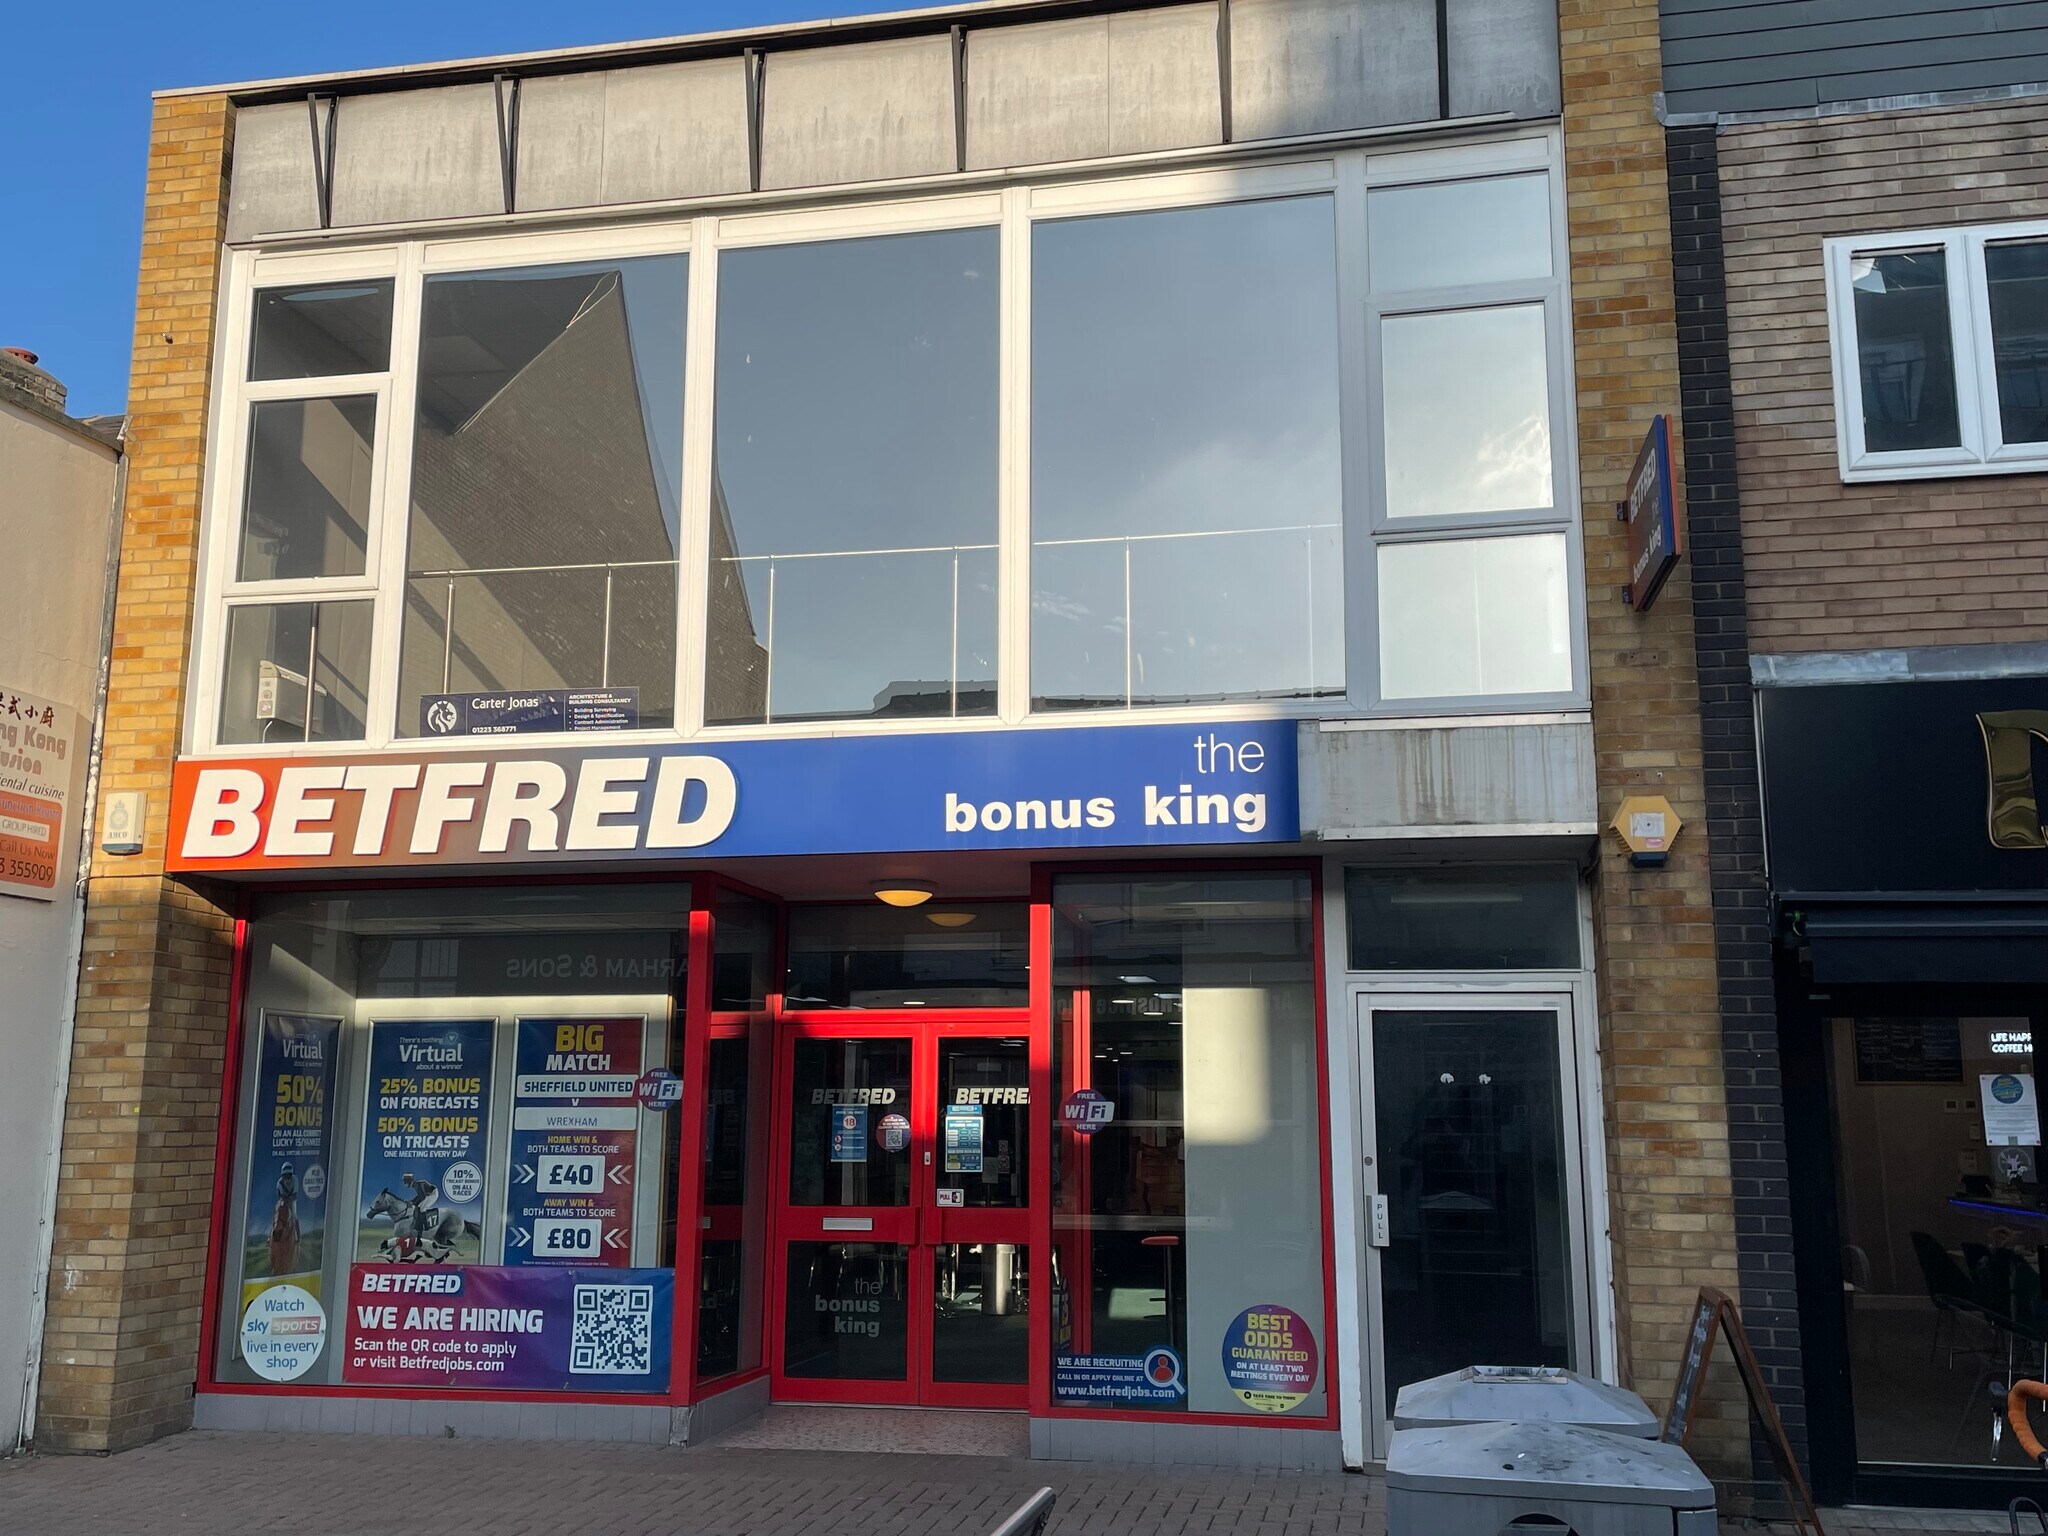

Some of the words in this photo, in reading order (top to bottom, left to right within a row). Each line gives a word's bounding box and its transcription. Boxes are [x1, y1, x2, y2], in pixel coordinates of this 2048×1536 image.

[471, 697, 507, 710] Carter
[507, 696, 539, 711] Jonas
[493, 725, 517, 733] 368771
[23, 724, 67, 760] Kong
[1193, 733, 1266, 774] the
[28, 782, 65, 800] cuisine
[181, 755, 738, 858] BETFRED
[945, 792, 1116, 833] bonus
[1144, 784, 1267, 833] king
[2, 818, 26, 832] GROUP
[27, 825, 47, 837] HIRED
[0, 839, 17, 853] Call
[20, 842, 32, 856] Us
[33, 846, 56, 860] Now
[9, 859, 54, 882] 355909
[555, 1024, 605, 1052] BIG
[1990, 1032, 2009, 1042] LIFE
[282, 1038, 323, 1060] Virtual
[399, 1043, 464, 1063] Virtual
[1991, 1043, 2024, 1053] COFFEE
[545, 1054, 611, 1071] MATCH
[277, 1074, 324, 1105] 50%
[380, 1078, 418, 1094] 25%
[422, 1077, 480, 1094] BONUS
[524, 1081, 586, 1092] SHEFFIELD
[589, 1081, 633, 1092] UNITED
[380, 1096, 399, 1110] ON
[401, 1096, 479, 1110] FORECASTS
[812, 1087, 896, 1105] BETFRED
[955, 1087, 1031, 1105] BETFRE
[1076, 1092, 1096, 1100] FREE
[273, 1106, 323, 1128] BONUS
[378, 1116, 415, 1133] 50%
[419, 1116, 479, 1133] BONUS
[546, 1117, 598, 1127] WREXHAM
[272, 1129, 282, 1138] ON
[282, 1129, 292, 1137] AN
[292, 1129, 303, 1137] ALL
[382, 1135, 401, 1149] ON
[405, 1135, 470, 1149] TRICASTS
[547, 1135, 571, 1144] HOME
[573, 1135, 590, 1144] WIN
[592, 1135, 598, 1144] &
[272, 1138, 293, 1147] LUCKY
[527, 1145, 548, 1153] BOTH
[550, 1145, 578, 1153] TEAMS
[580, 1145, 591, 1153] TO
[592, 1145, 620, 1154] SCORE
[383, 1150, 398, 1158] ONE
[399, 1150, 428, 1158] MEETING
[429, 1150, 451, 1158] EVERY
[452, 1150, 467, 1158] DAY
[453, 1169, 474, 1179] 10%
[549, 1164, 594, 1185] £40
[543, 1198, 567, 1207] AWAY
[569, 1198, 586, 1207] WIN
[588, 1198, 594, 1207] &
[523, 1208, 544, 1216] BOTH
[546, 1208, 574, 1216] TEAMS
[576, 1208, 587, 1216] TO
[588, 1208, 617, 1217] SCORE
[1376, 1203, 1384, 1239] PULL
[547, 1228, 591, 1249] £80
[361, 1273, 462, 1293] BETFRED
[854, 1277, 881, 1295] the
[264, 1298, 305, 1312] Watch
[814, 1294, 881, 1313] bonus
[246, 1318, 270, 1335] sky
[273, 1319, 319, 1334] sports
[356, 1305, 398, 1330] WE
[403, 1306, 455, 1331] ARE
[459, 1307, 544, 1333] HIRING
[834, 1316, 881, 1338] king
[1247, 1313, 1292, 1331] BEST
[246, 1339, 268, 1354] live
[270, 1340, 281, 1353] in
[283, 1341, 319, 1355] every
[354, 1337, 384, 1351] Scan
[386, 1337, 407, 1352] the
[410, 1338, 430, 1355] QR
[432, 1339, 461, 1353] code
[464, 1340, 478, 1354] to
[481, 1340, 517, 1359] apply
[1244, 1330, 1294, 1349] ODDS
[1057, 1357, 1072, 1366] WE
[1073, 1358, 1091, 1367] ARE
[1092, 1358, 1144, 1368] RECRUITING
[1231, 1346, 1309, 1362] GUARANTEED
[266, 1355, 299, 1371] shop
[353, 1357, 367, 1367] or
[369, 1355, 396, 1369] visit
[399, 1355, 505, 1374] Betfredjobs.com
[1236, 1361, 1248, 1370] ON
[1248, 1362, 1259, 1370] AT
[1260, 1363, 1285, 1372] LEAST
[1286, 1365, 1304, 1373] TWO
[1230, 1370, 1268, 1381] MEETINGS
[1269, 1373, 1294, 1382] EVERY
[1295, 1374, 1310, 1382] DAY
[1057, 1384, 1176, 1400] www.betfredjobs.com
